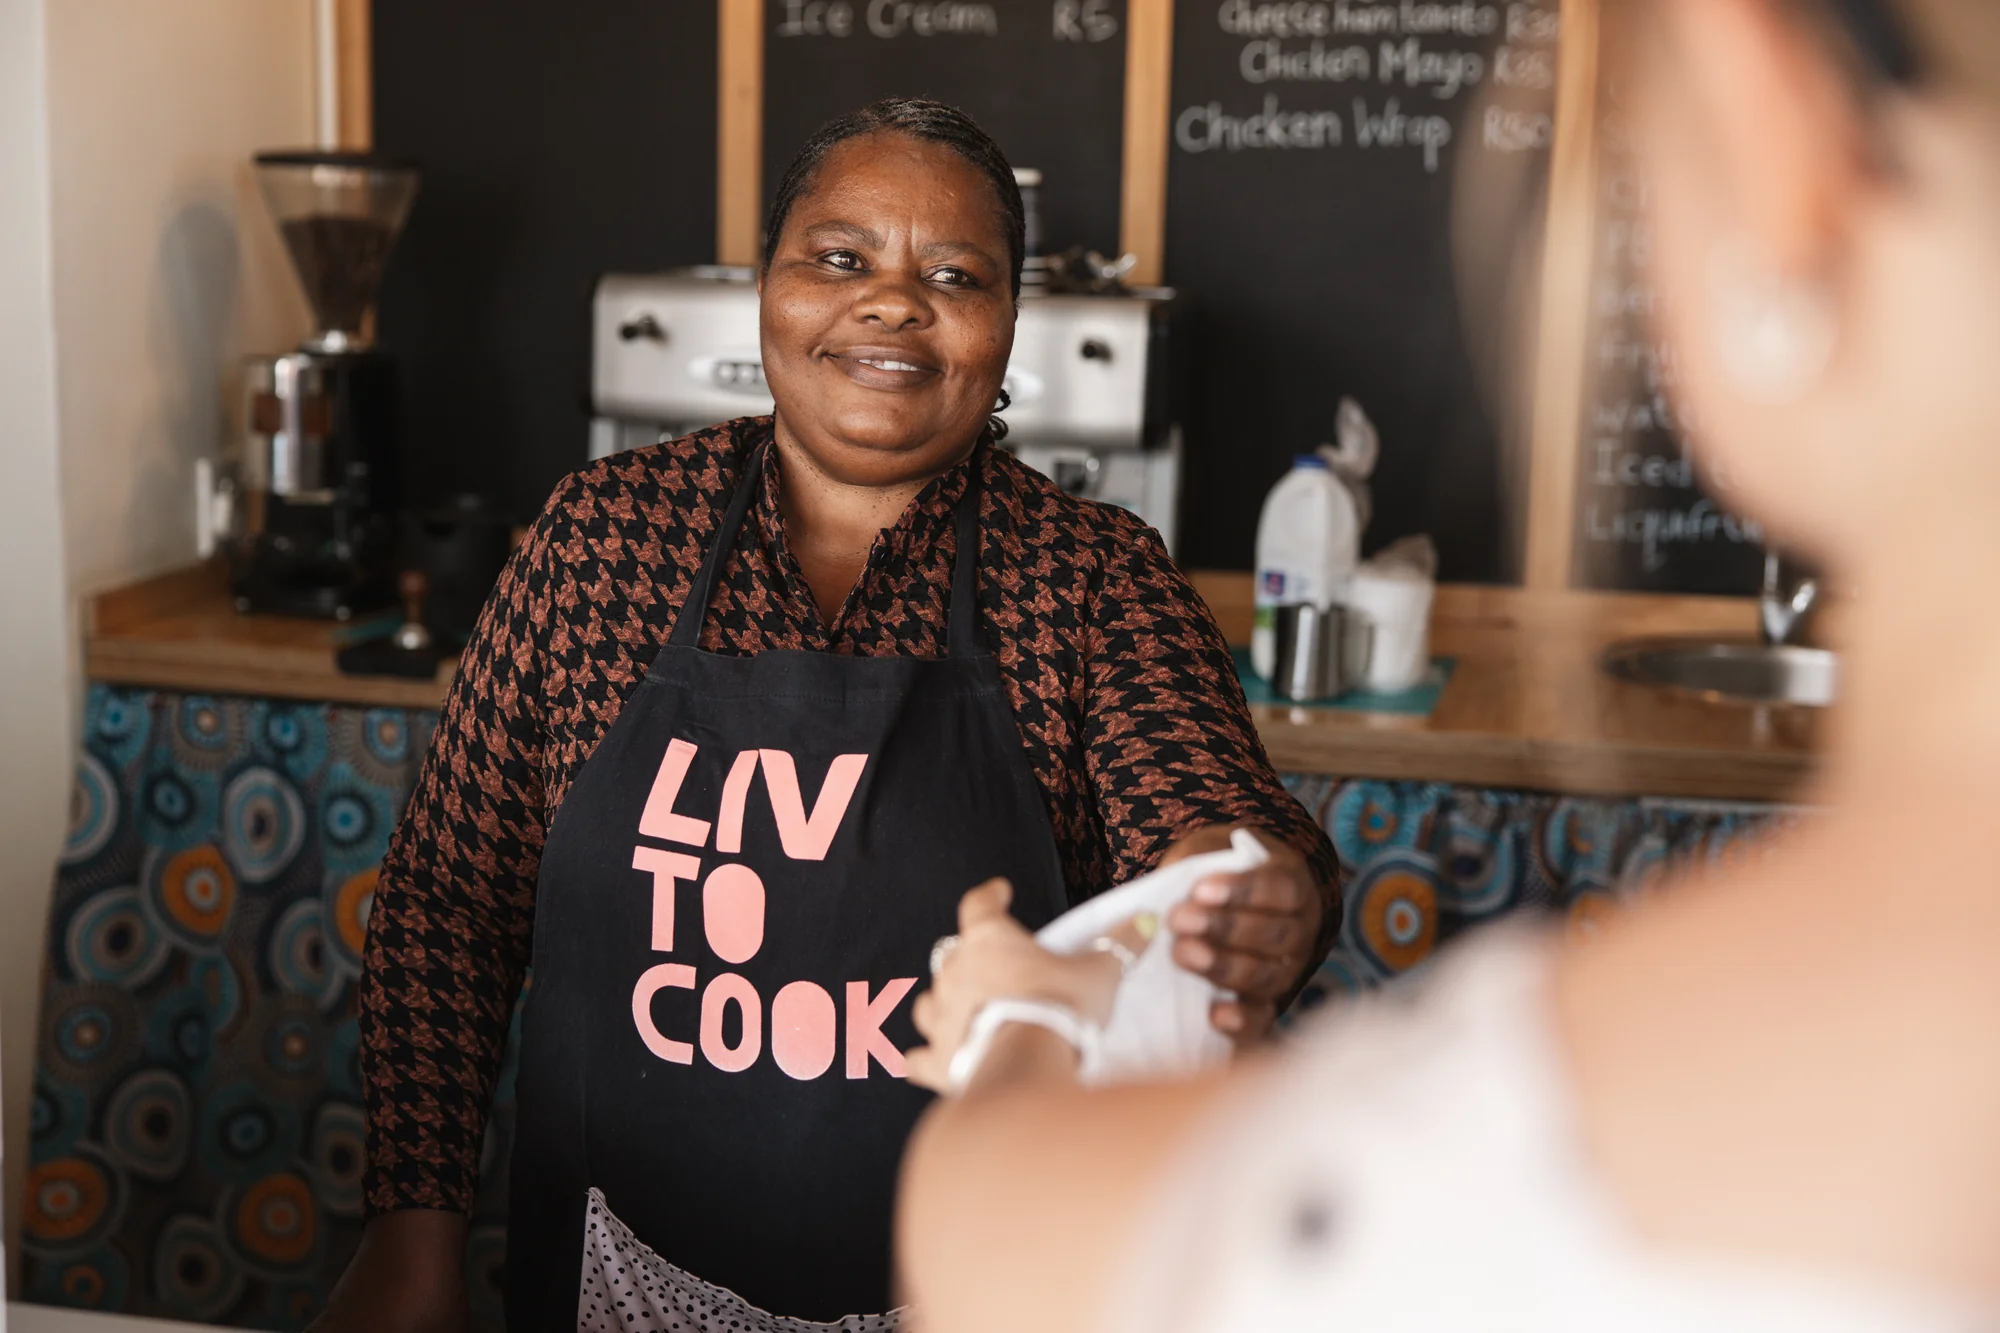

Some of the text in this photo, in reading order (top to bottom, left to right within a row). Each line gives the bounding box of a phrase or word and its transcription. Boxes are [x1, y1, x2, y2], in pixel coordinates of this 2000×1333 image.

[776, 0, 853, 37] Ice
[866, 0, 998, 38] Cream
[1240, 37, 1370, 84] Chicken
[1378, 36, 1484, 99] Mayo
[1175, 93, 1342, 153] Chicken
[1352, 96, 1452, 173] Wrap
[639, 738, 869, 861] LIV
[632, 845, 766, 964] TO
[632, 963, 920, 1081] COOK
